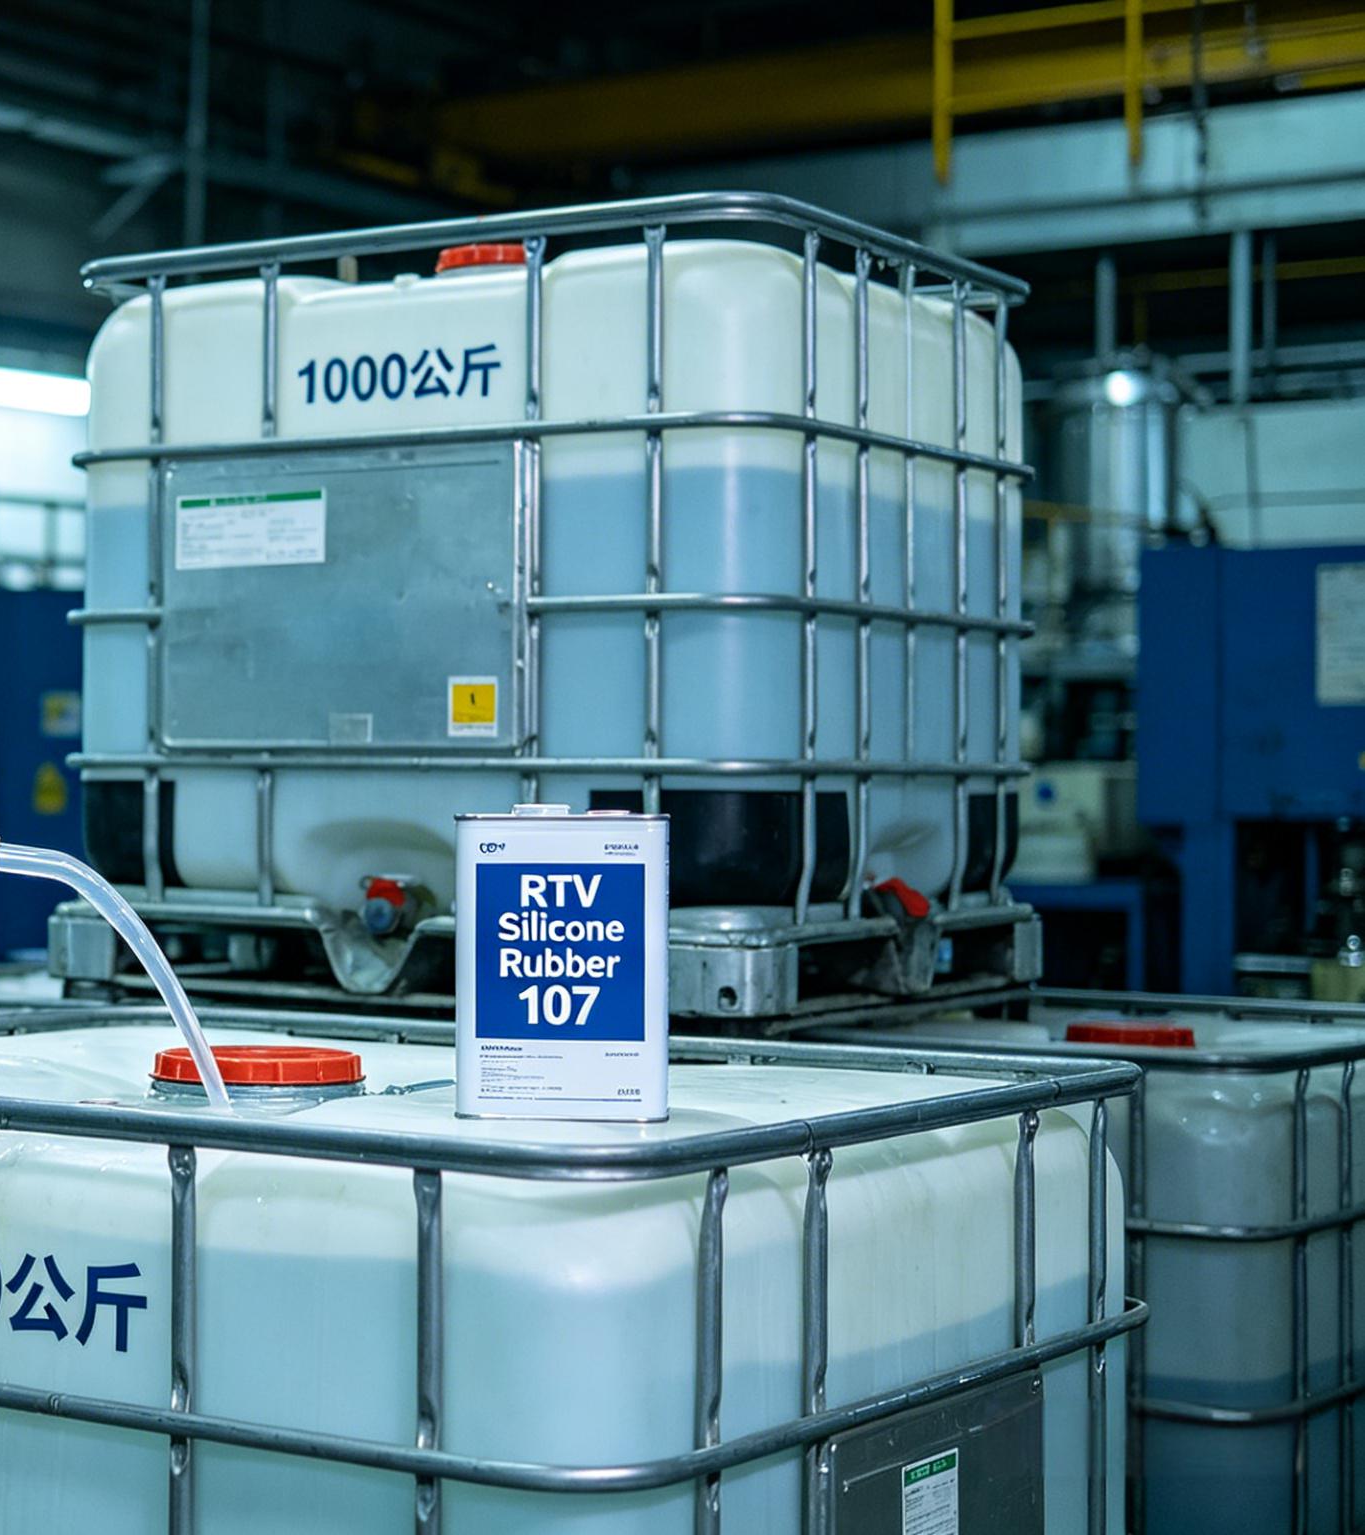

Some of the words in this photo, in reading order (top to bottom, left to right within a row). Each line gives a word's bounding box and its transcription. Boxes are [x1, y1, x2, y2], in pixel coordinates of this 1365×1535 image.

[298, 343, 501, 404] 1000公斤
[520, 874, 602, 908] RTV
[498, 911, 625, 942] Silicone
[499, 948, 621, 978] Rubber
[518, 985, 601, 1026] 107
